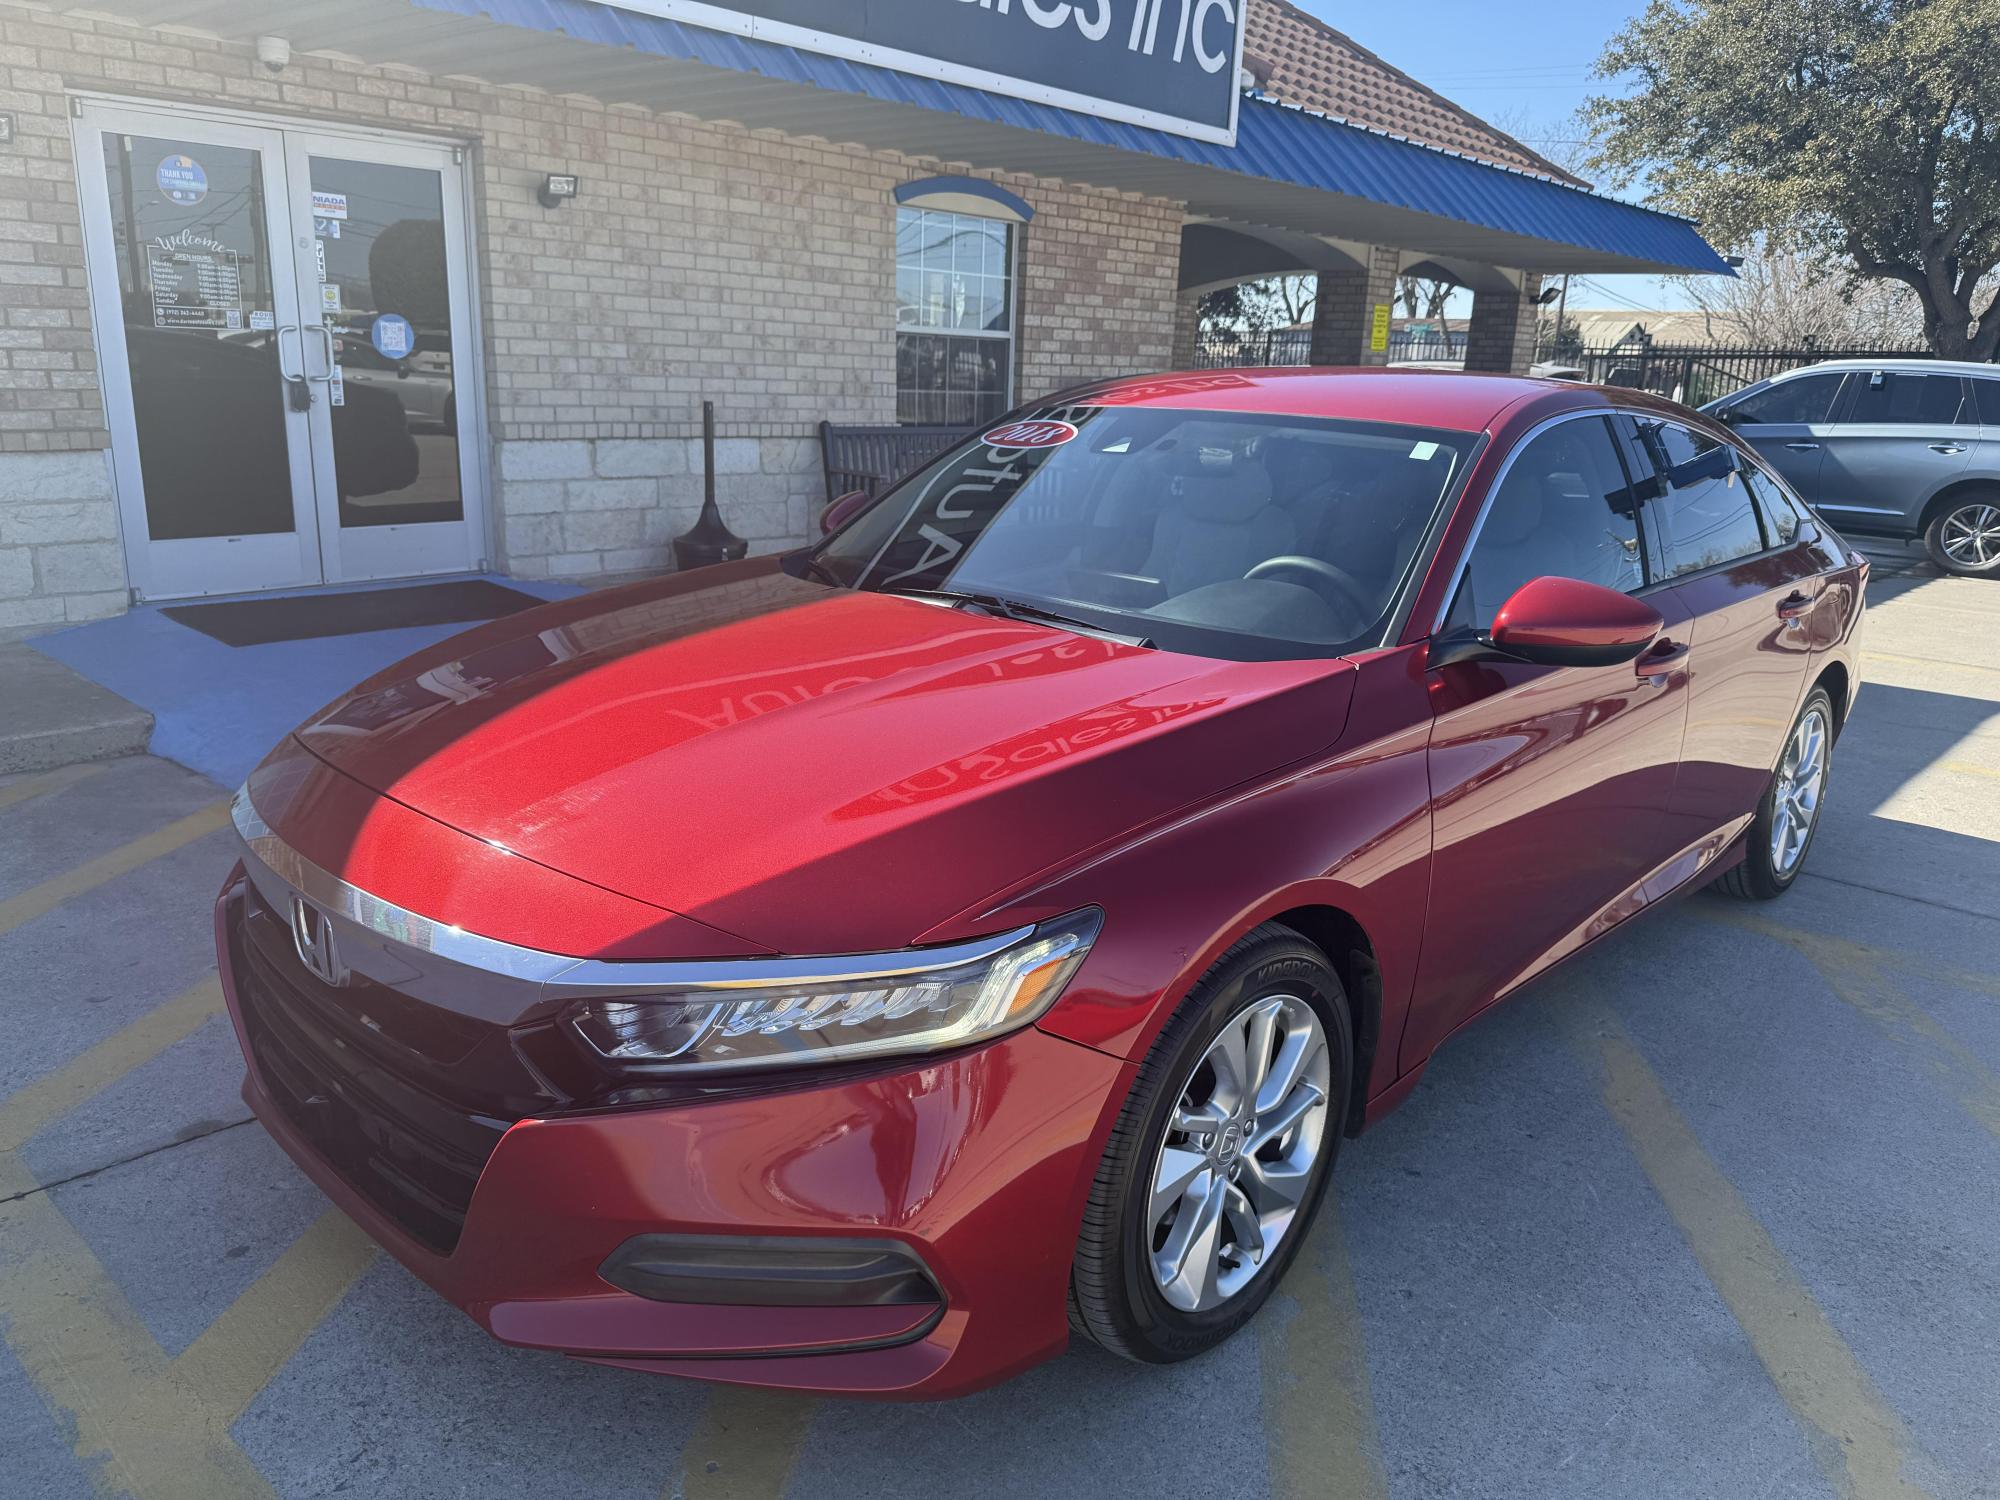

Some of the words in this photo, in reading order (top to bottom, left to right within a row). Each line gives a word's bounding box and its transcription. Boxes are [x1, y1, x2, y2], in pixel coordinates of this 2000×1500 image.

[160, 168, 181, 179] THANK
[181, 170, 194, 180] YOU
[312, 195, 345, 205] NIADA
[155, 228, 225, 253] Welcome
[989, 425, 1067, 443] 2018
